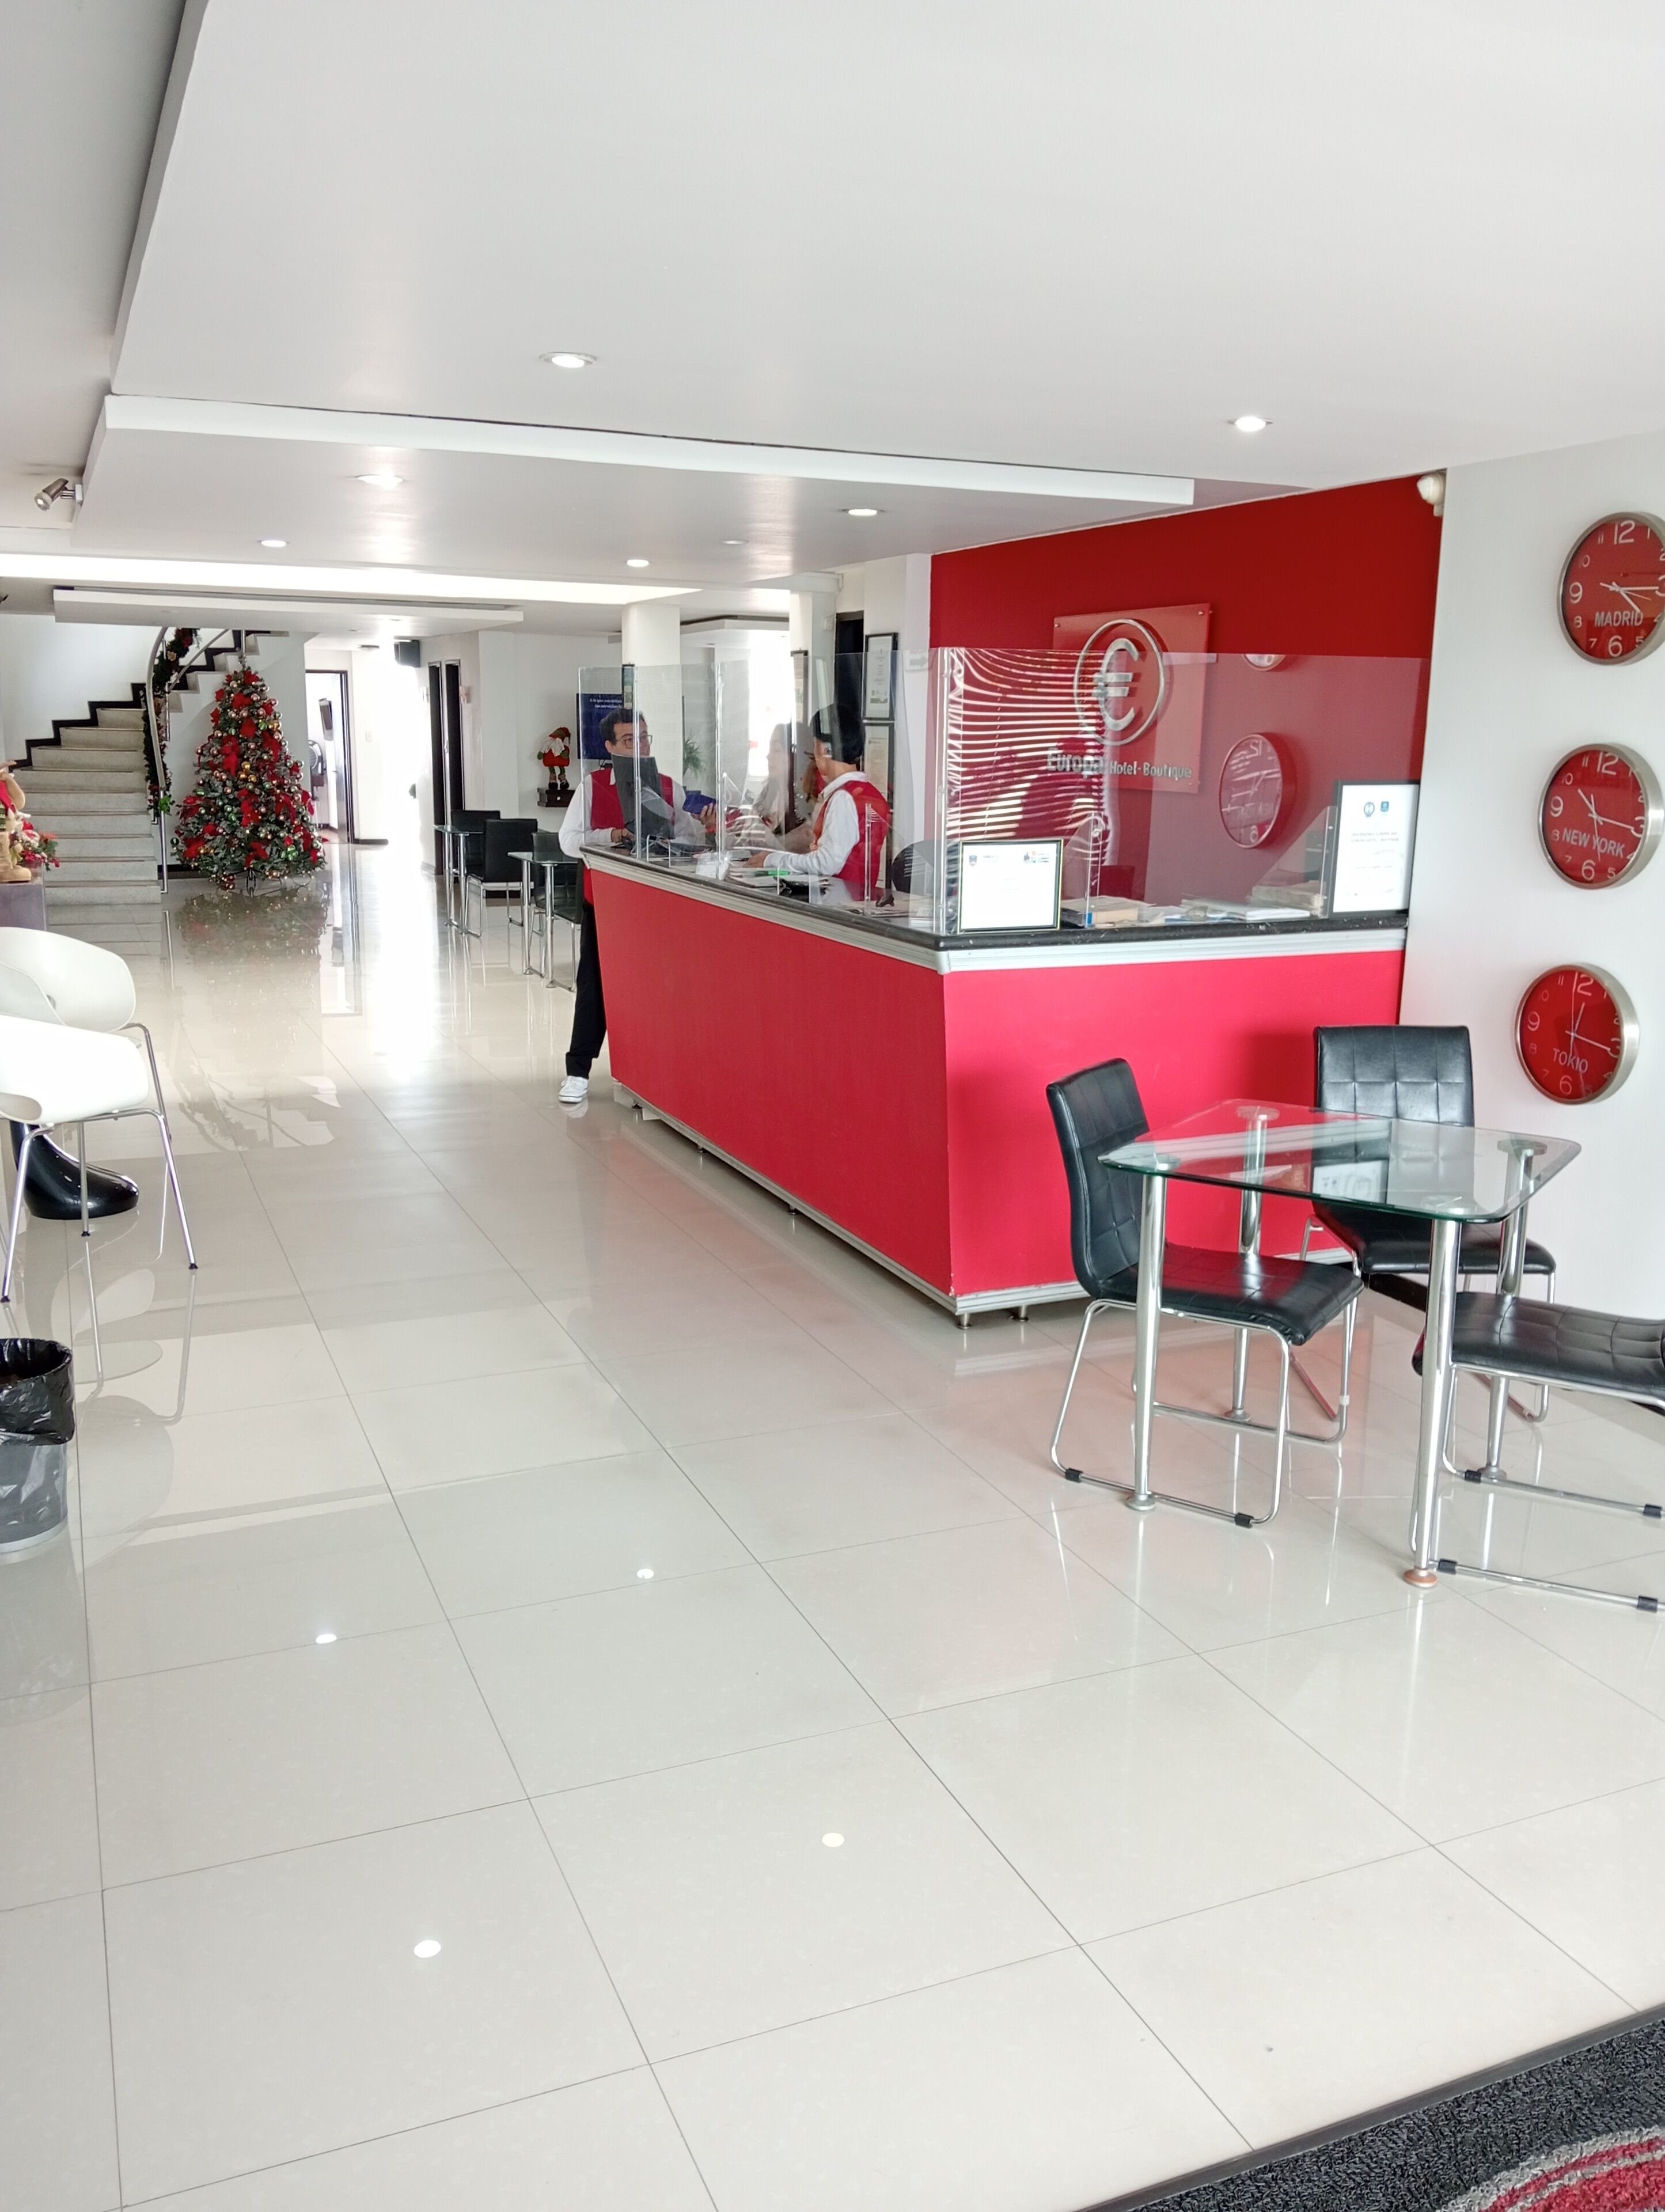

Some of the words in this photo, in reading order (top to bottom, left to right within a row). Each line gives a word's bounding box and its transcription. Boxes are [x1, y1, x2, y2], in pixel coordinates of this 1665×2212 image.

[1614, 520, 1636, 545] 12
[1569, 582, 1583, 604] 9
[1573, 616, 1582, 628] 8
[1594, 611, 1643, 627] MADRID
[1588, 638, 1597, 649] 7
[1608, 635, 1622, 657] 6
[1046, 747, 1104, 778] Europa
[1597, 751, 1619, 775] 12
[1550, 796, 1564, 817] 9
[1552, 829, 1560, 841] 8
[1562, 827, 1590, 849] NEW
[1592, 836, 1625, 858] YORK
[1564, 855, 1572, 863] 7
[1581, 859, 1596, 881] 6
[1607, 867, 1616, 879] 5
[1573, 972, 1594, 996] 12
[1527, 1011, 1541, 1031] 9
[1530, 1043, 1537, 1054] 8
[1553, 1048, 1588, 1074] TOKIO
[1542, 1068, 1550, 1079] 7
[1560, 1075, 1573, 1095] 6
